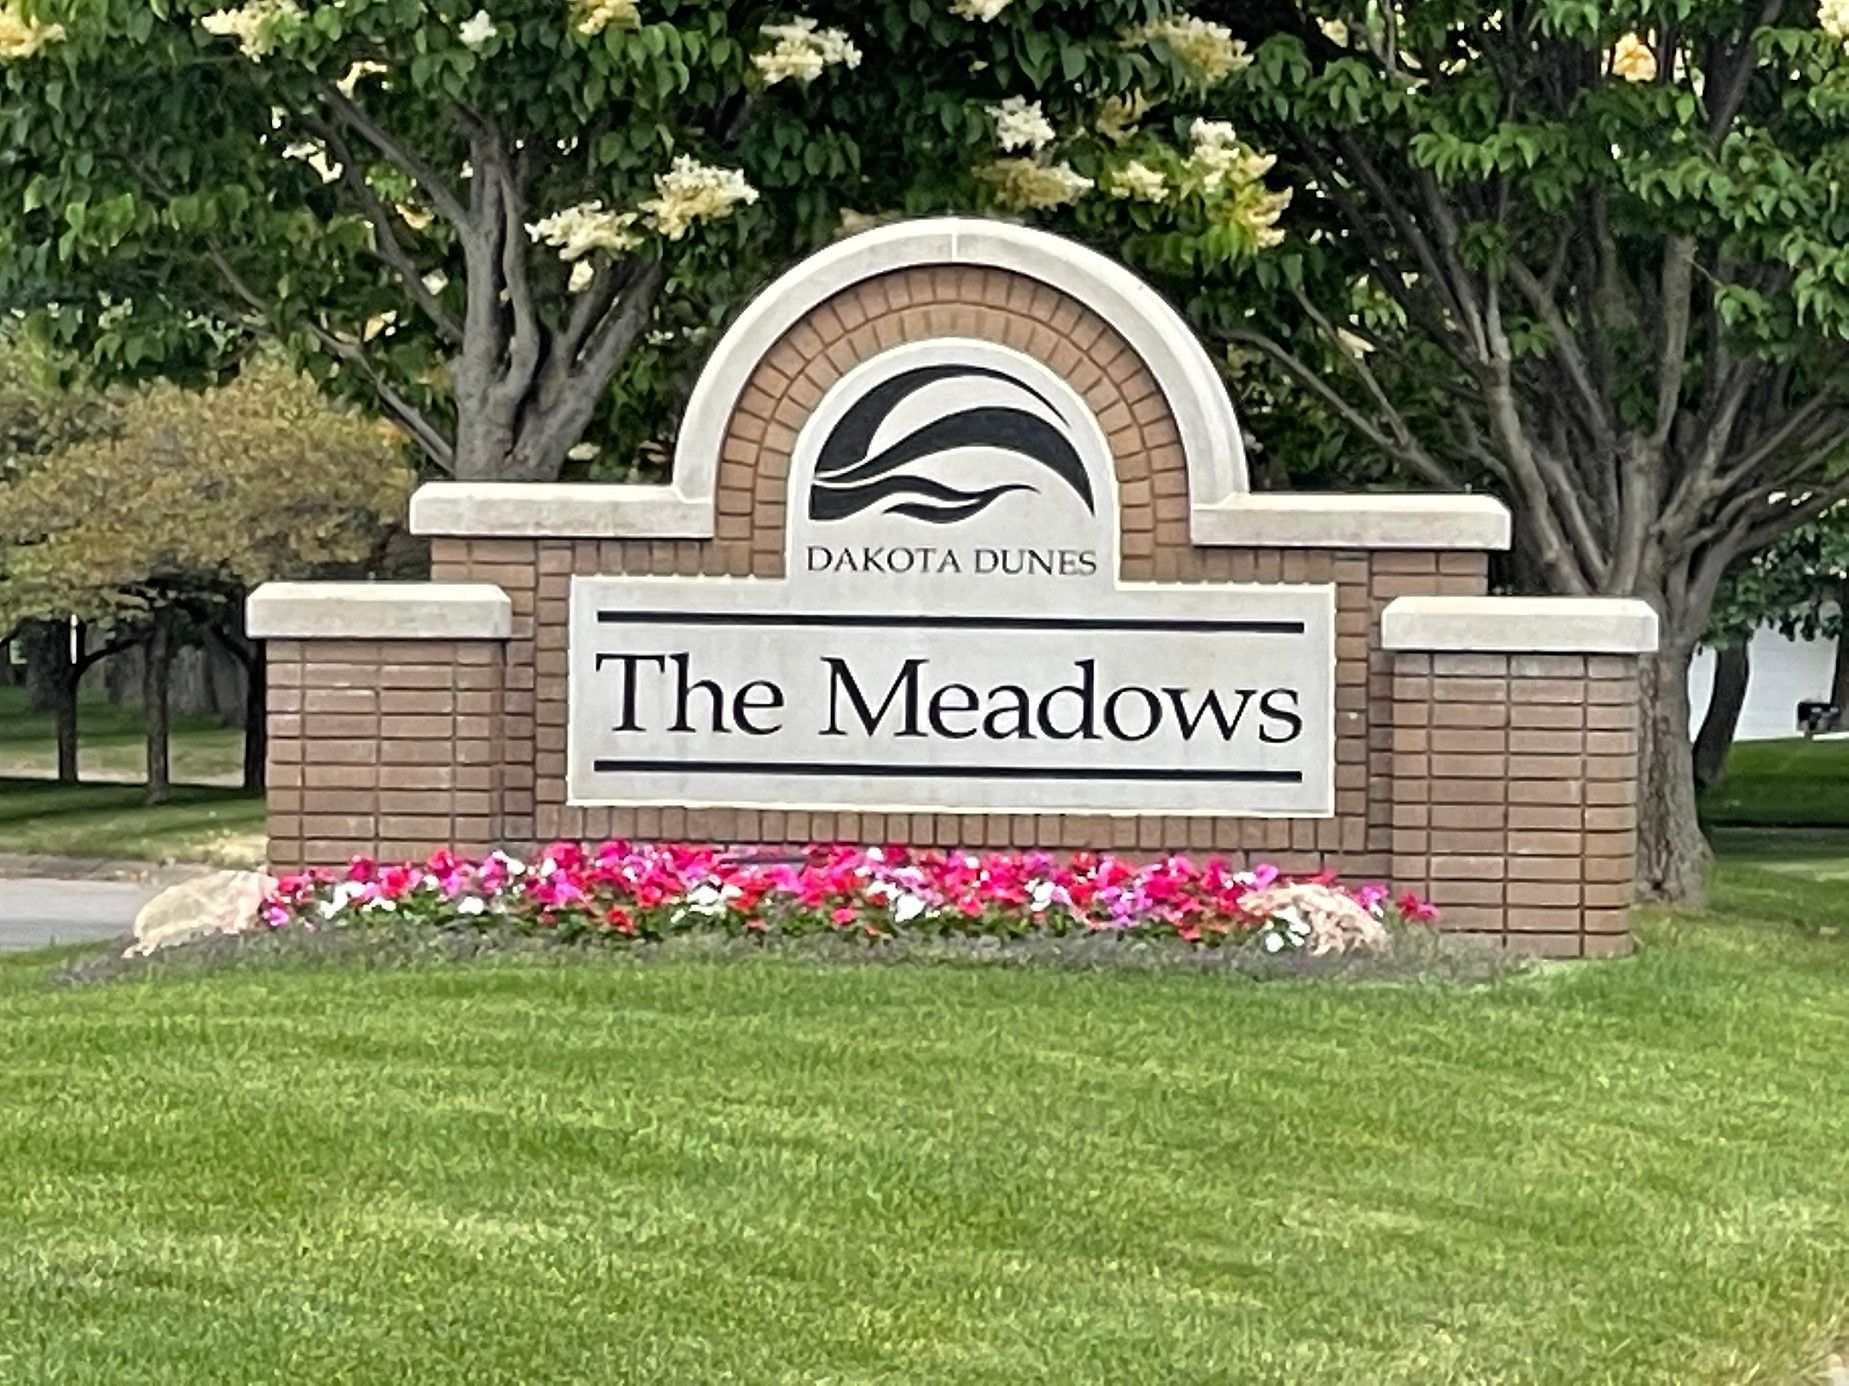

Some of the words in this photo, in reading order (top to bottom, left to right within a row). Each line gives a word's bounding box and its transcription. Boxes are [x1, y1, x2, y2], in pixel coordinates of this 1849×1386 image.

[807, 546, 962, 574] DAKOTA
[974, 548, 1097, 576] DUNES
[595, 652, 784, 736] The
[818, 657, 1303, 744] Meadows
